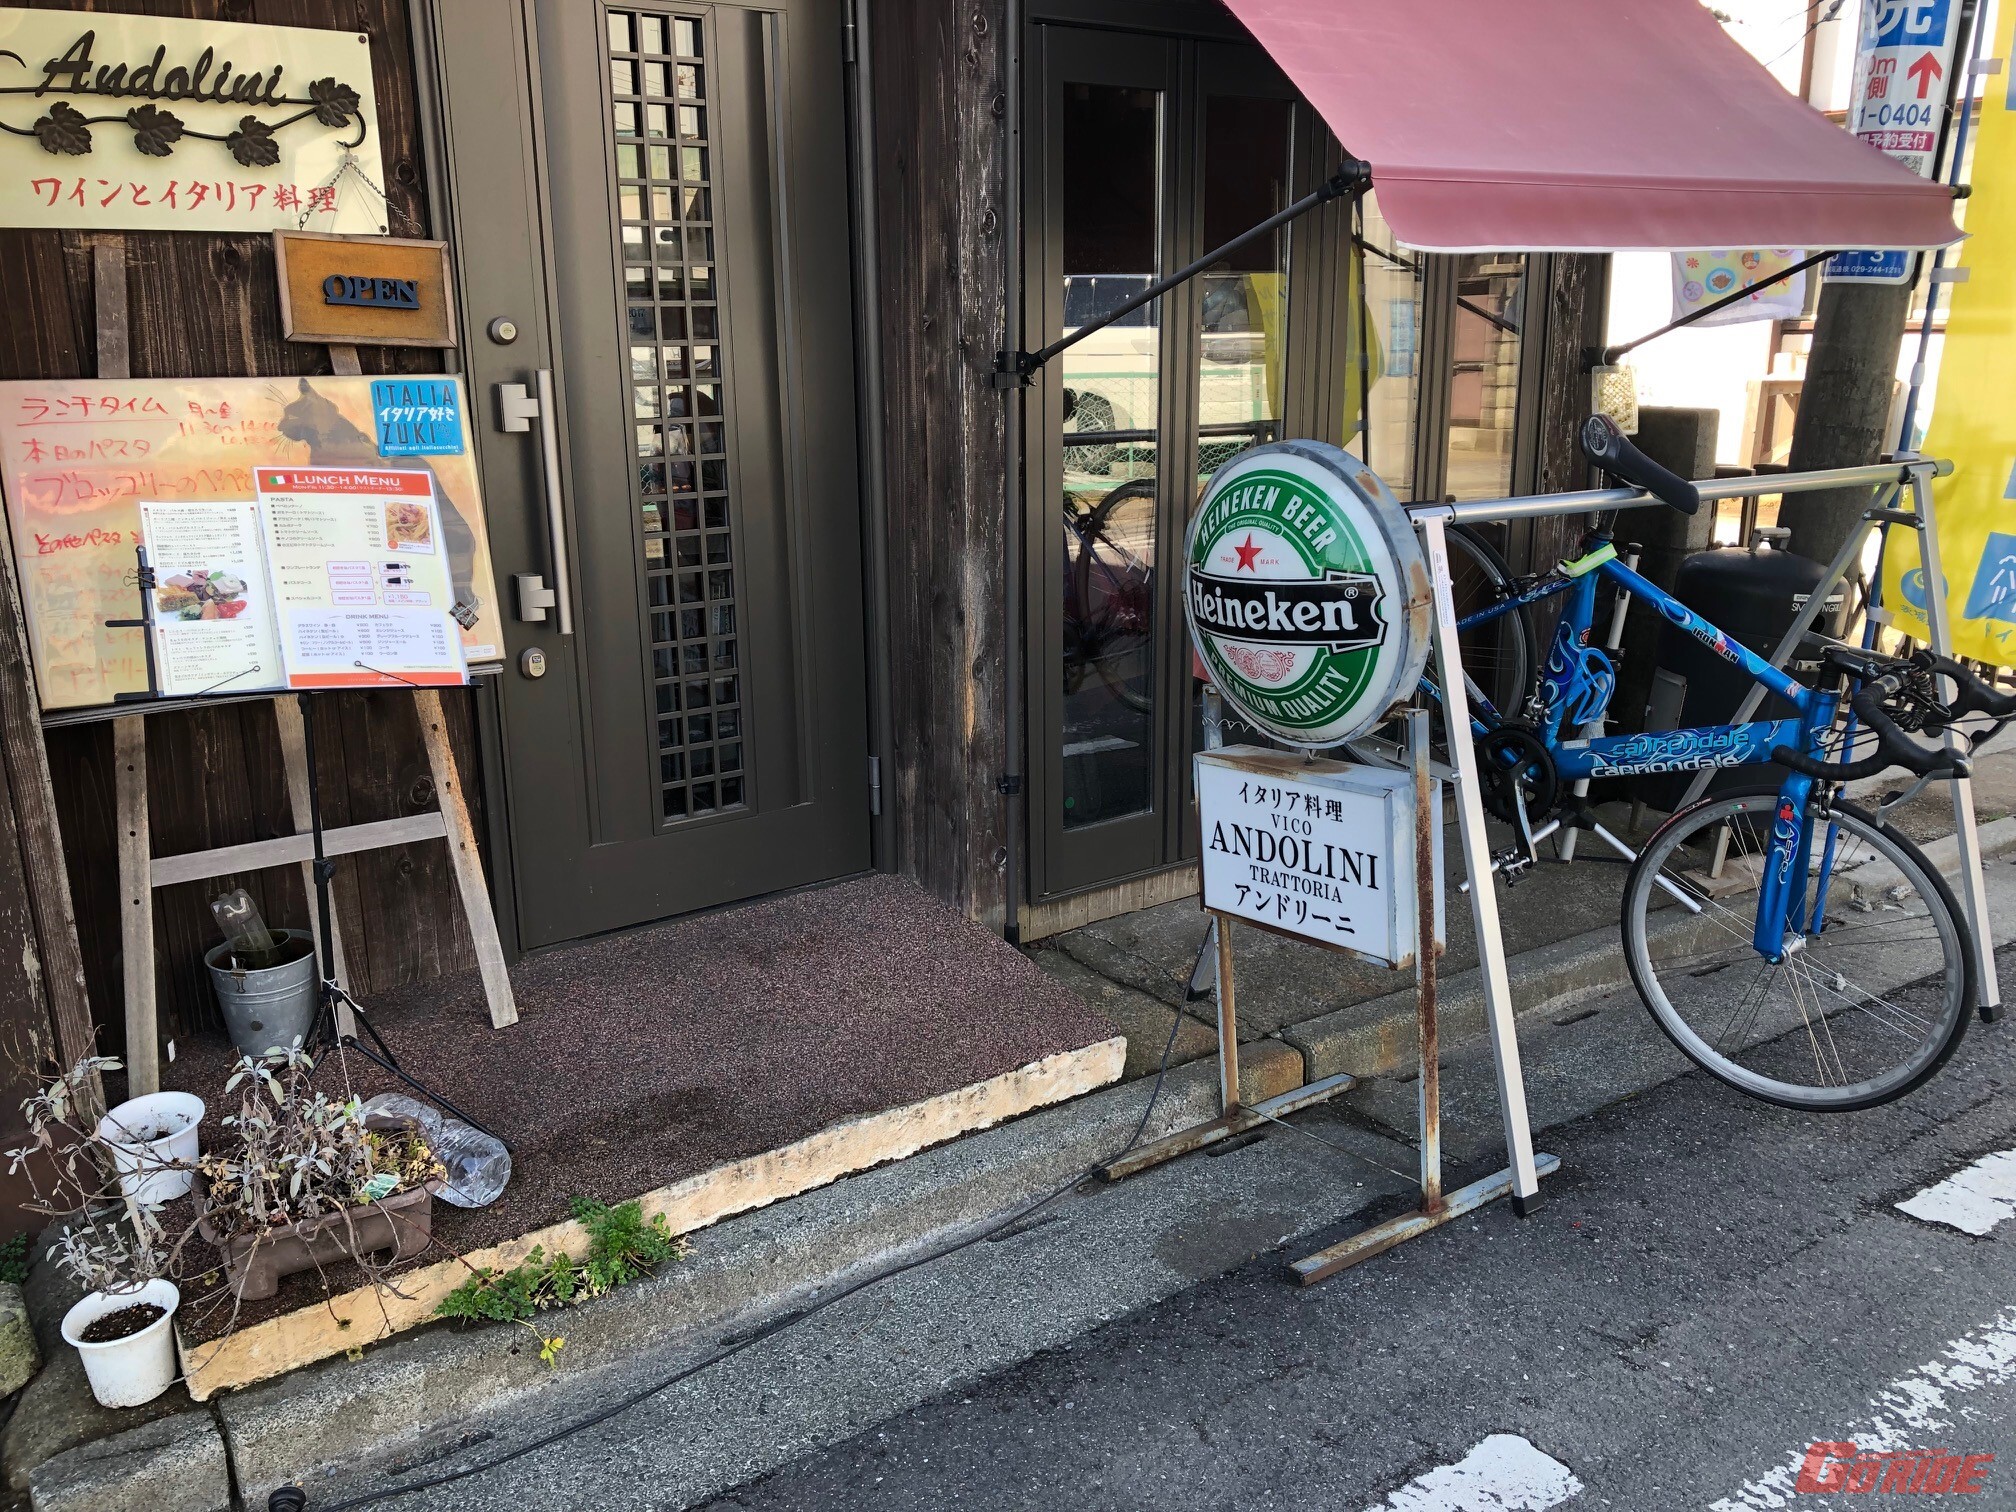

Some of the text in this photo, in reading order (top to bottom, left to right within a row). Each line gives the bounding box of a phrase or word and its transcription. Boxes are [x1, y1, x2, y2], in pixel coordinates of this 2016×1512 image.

[35, 30, 287, 107] Andolini
[31, 177, 338, 213] ワインとイタリア料理
[323, 273, 422, 308] OPEN
[22, 396, 168, 420] ランチタイム
[376, 384, 454, 406] ITALIA
[380, 406, 455, 422] イタリア好き
[382, 423, 436, 444] ZUKI
[22, 438, 150, 463] 本日のパスタ
[293, 473, 400, 487] LUNCH MENU
[1200, 485, 1338, 554] HEINEKEN BEER
[1258, 519, 1280, 533] QUALITY
[1260, 558, 1280, 566] MARK
[1192, 579, 1358, 632] Heineken
[1475, 610, 1486, 618] IN
[1488, 603, 1506, 614] USA
[1692, 627, 1740, 664] IRONMAN
[1210, 652, 1350, 720] PREMIUM QUALITY
[1612, 730, 1750, 757] cannondale
[1590, 753, 1740, 778] cannondale
[1239, 782, 1343, 823] イタリア料理
[1271, 813, 1312, 836] VICO
[1209, 820, 1379, 890] ANDOLINI
[1250, 864, 1343, 903] TRATTORIA
[1234, 883, 1355, 934] アンドリーニ
